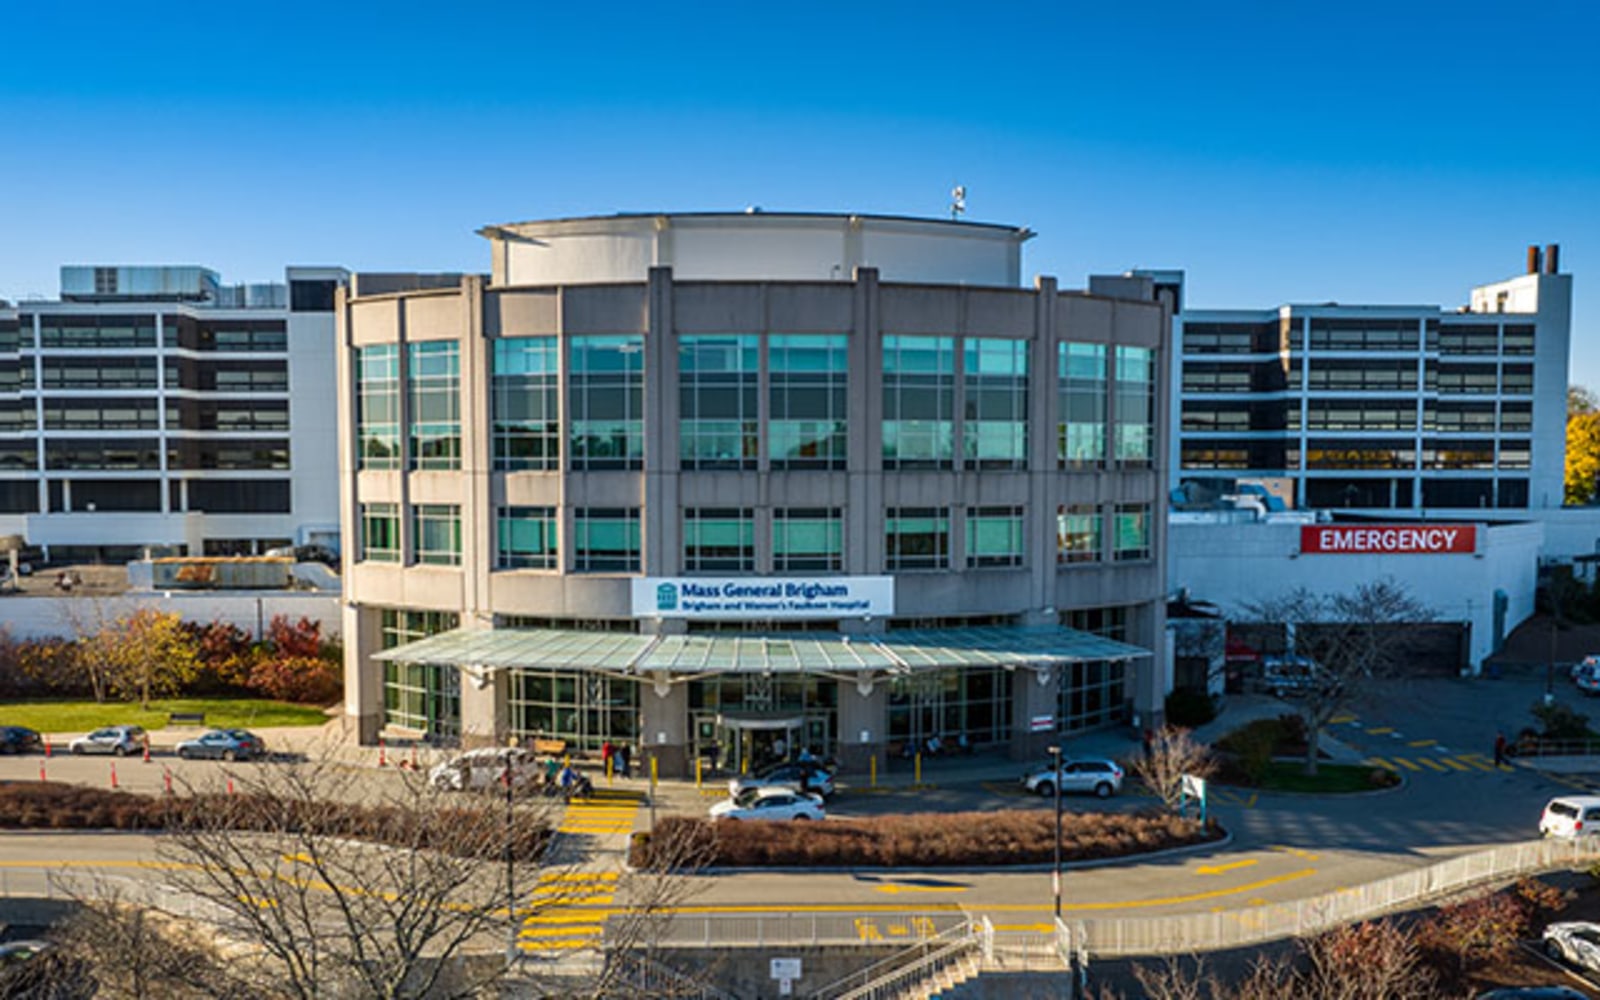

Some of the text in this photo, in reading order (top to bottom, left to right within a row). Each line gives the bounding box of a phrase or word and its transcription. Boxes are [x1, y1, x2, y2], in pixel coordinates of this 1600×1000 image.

[1319, 530, 1457, 549] EMERGENCY
[682, 582, 848, 599] Mass General Brigham
[682, 601, 721, 612] Brigham
[724, 602, 741, 610] and
[744, 602, 786, 611] Women's
[830, 600, 870, 612] Hospital
